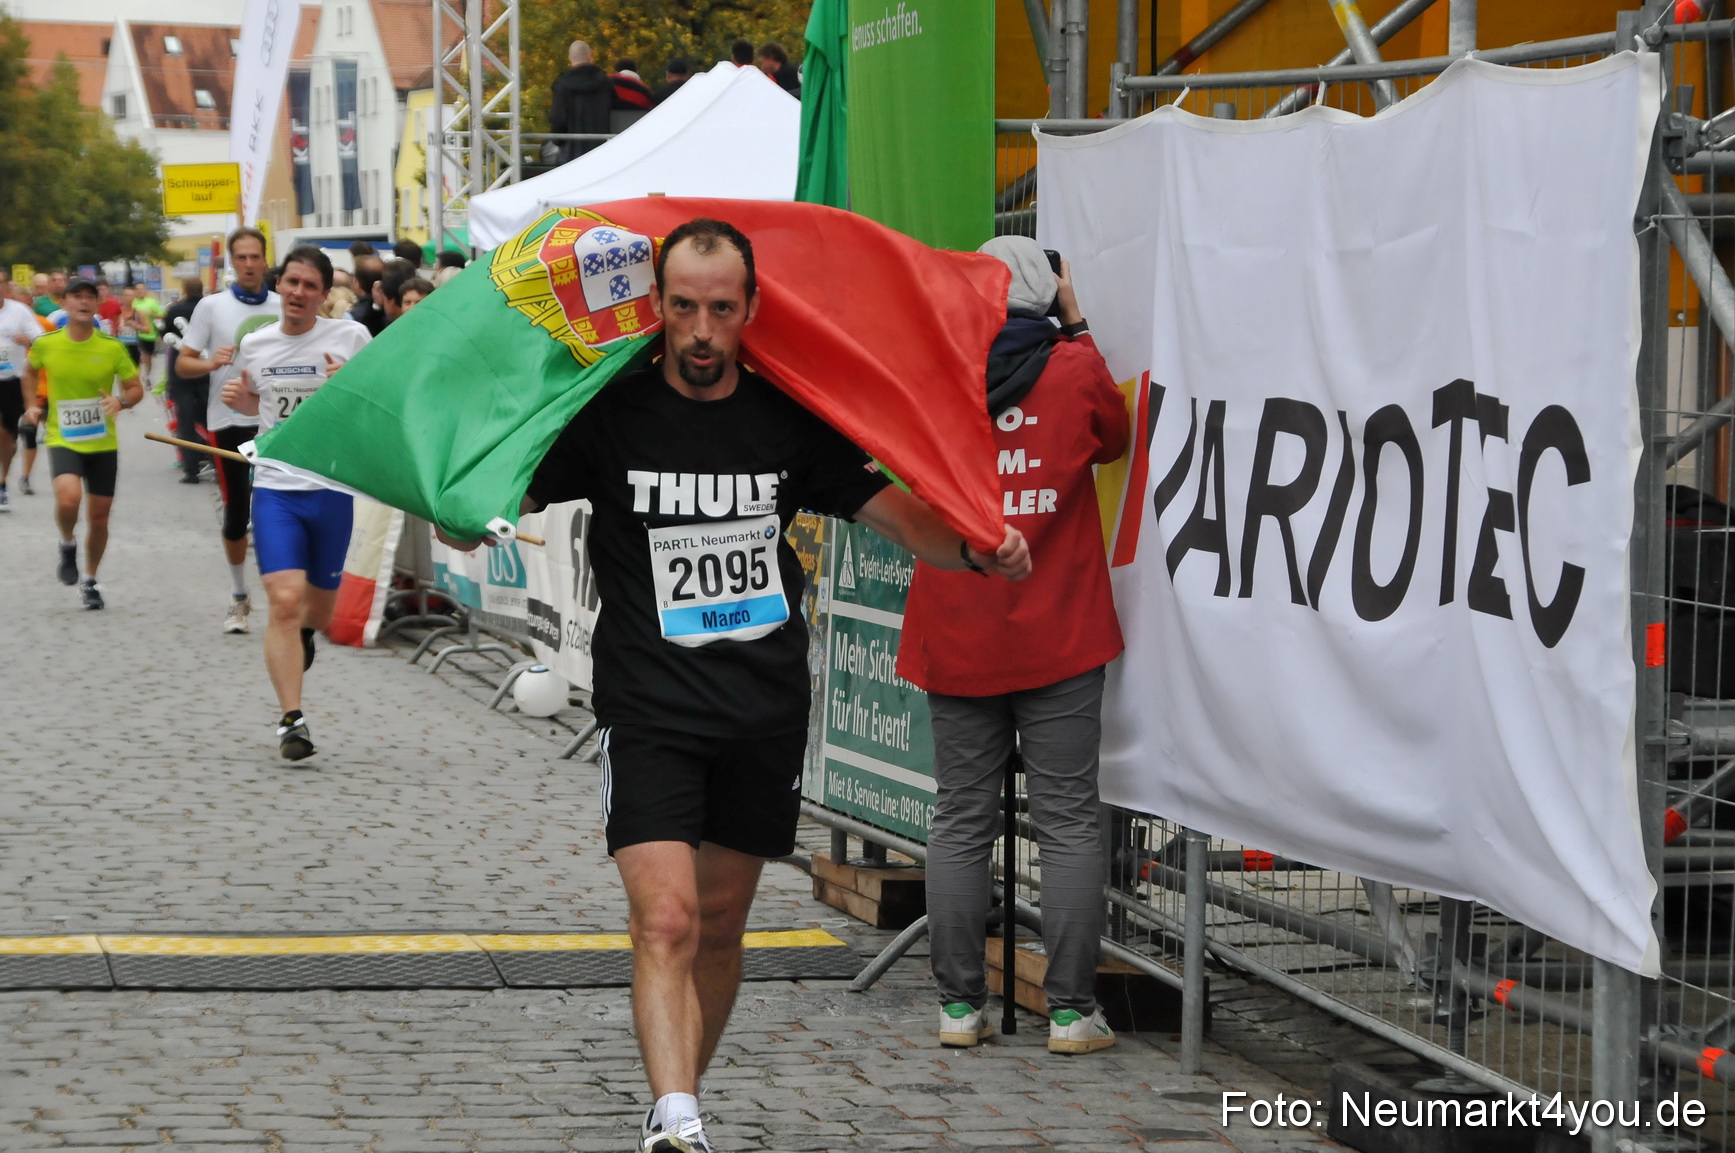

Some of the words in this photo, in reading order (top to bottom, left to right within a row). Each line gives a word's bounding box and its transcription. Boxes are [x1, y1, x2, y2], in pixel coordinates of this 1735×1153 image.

[876, 1, 922, 45] schaffen.
[167, 178, 235, 189] Schnupper-
[191, 191, 213, 201] lauf
[62, 407, 101, 426] 3304
[743, 503, 775, 512] SWEDEN
[1148, 377, 1591, 649] VARIOTEC
[653, 537, 699, 552] PARTL
[701, 530, 761, 548] Neumarkt
[668, 546, 769, 602] 2095
[702, 609, 751, 629] Marco
[834, 631, 867, 675] Mehr
[832, 686, 851, 733] für
[852, 693, 869, 739] Ihr
[871, 700, 911, 752] Event!
[828, 770, 846, 800] Miet
[846, 776, 853, 802] &
[854, 779, 880, 812] Service
[880, 788, 899, 819] Line:
[900, 795, 924, 828] 09181
